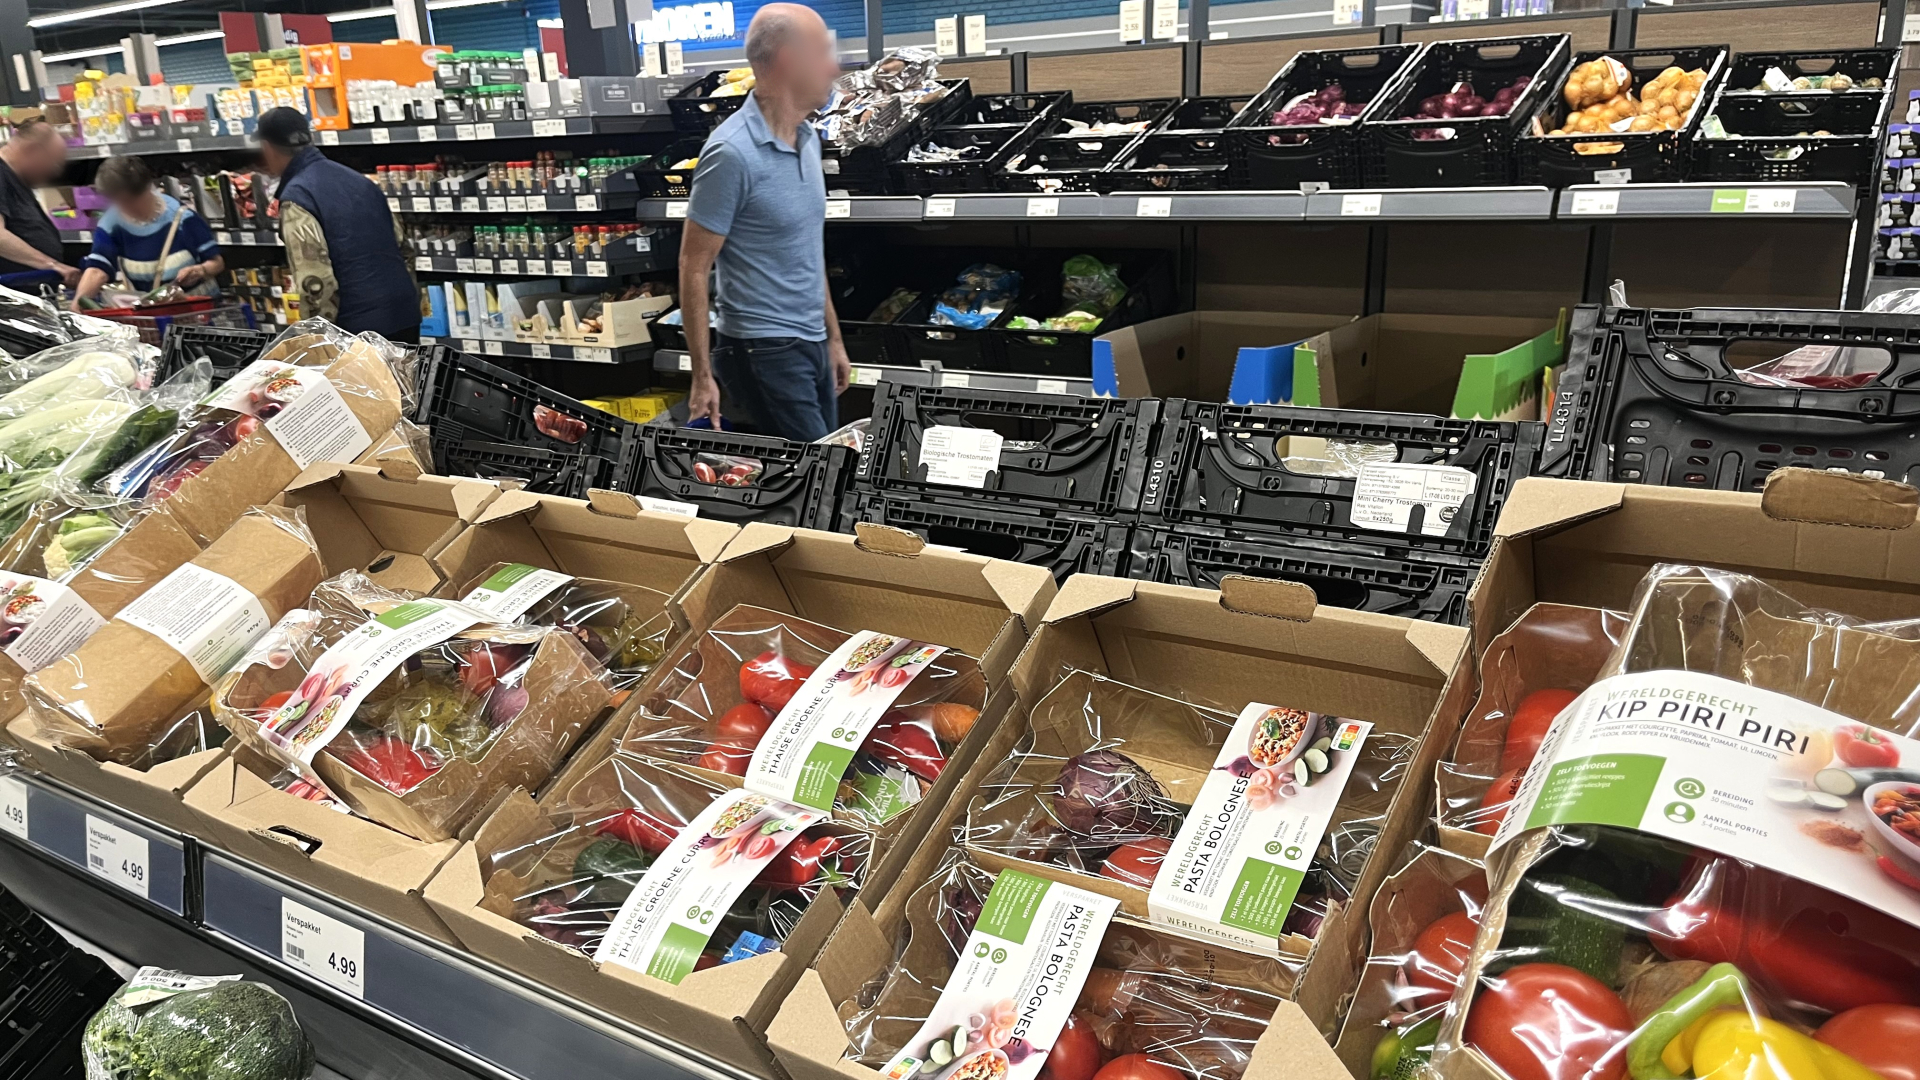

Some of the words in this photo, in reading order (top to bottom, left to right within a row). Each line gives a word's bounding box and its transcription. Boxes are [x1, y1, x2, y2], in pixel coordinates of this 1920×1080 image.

[1550, 391, 1574, 443] LL4314
[858, 433, 875, 477] LL4310
[923, 449, 956, 458] Biologische
[957, 452, 994, 462] Trostomaten
[1146, 460, 1164, 505] LL4310
[1372, 496, 1394, 505] Cherry
[368, 635, 412, 670] GROENE
[1607, 687, 1759, 717] WERELDGERECHT
[769, 736, 794, 775] THAISE
[791, 696, 824, 736] GROENE
[820, 667, 847, 696] CURRY
[1597, 700, 1648, 723] KIP
[1657, 701, 1727, 731] PIRI
[1738, 718, 1810, 755] PIRI
[1626, 723, 1639, 731] MET
[1639, 723, 1679, 734] COURGETTE,
[1679, 729, 1709, 741] PAPRIKA,
[1710, 737, 1739, 750] TOMAAT,
[759, 707, 802, 772] WERELDGERECHT
[1541, 724, 1561, 755] KIP
[1621, 730, 1638, 738] RODE
[1639, 730, 1660, 739] PEPER
[1669, 734, 1711, 749] KRUIDENMIX.
[1517, 760, 1542, 800] PIRI
[1556, 766, 1573, 776] ZELF
[1573, 762, 1618, 773] TOEVOEGEN
[5, 804, 23, 824] 4.99
[1713, 789, 1754, 806] BEREIDING
[1720, 798, 1748, 811] minuten
[89, 826, 117, 846] Verspakket
[1183, 854, 1212, 894] PASTA
[1209, 771, 1253, 849] BOLOGNESE
[1494, 802, 1521, 844] PIRI
[1701, 820, 1713, 829] 3-4
[1713, 824, 1737, 836] porties
[1704, 813, 1733, 827] AANTAL
[1735, 822, 1768, 838] PORTIES
[1171, 814, 1214, 888] WERELDGERECHT
[122, 859, 144, 881] 4.99
[618, 915, 647, 959] THAISE
[645, 866, 683, 913] GROENE
[681, 832, 712, 865] CURRY
[286, 912, 321, 935] Verspakket
[609, 880, 659, 955] WERELDGERECHT
[1055, 904, 1085, 948] PASTA
[328, 951, 357, 979] 4.99
[1053, 910, 1097, 996] WERELDGERECHT
[1008, 953, 1064, 1047] BOLOGNESE
